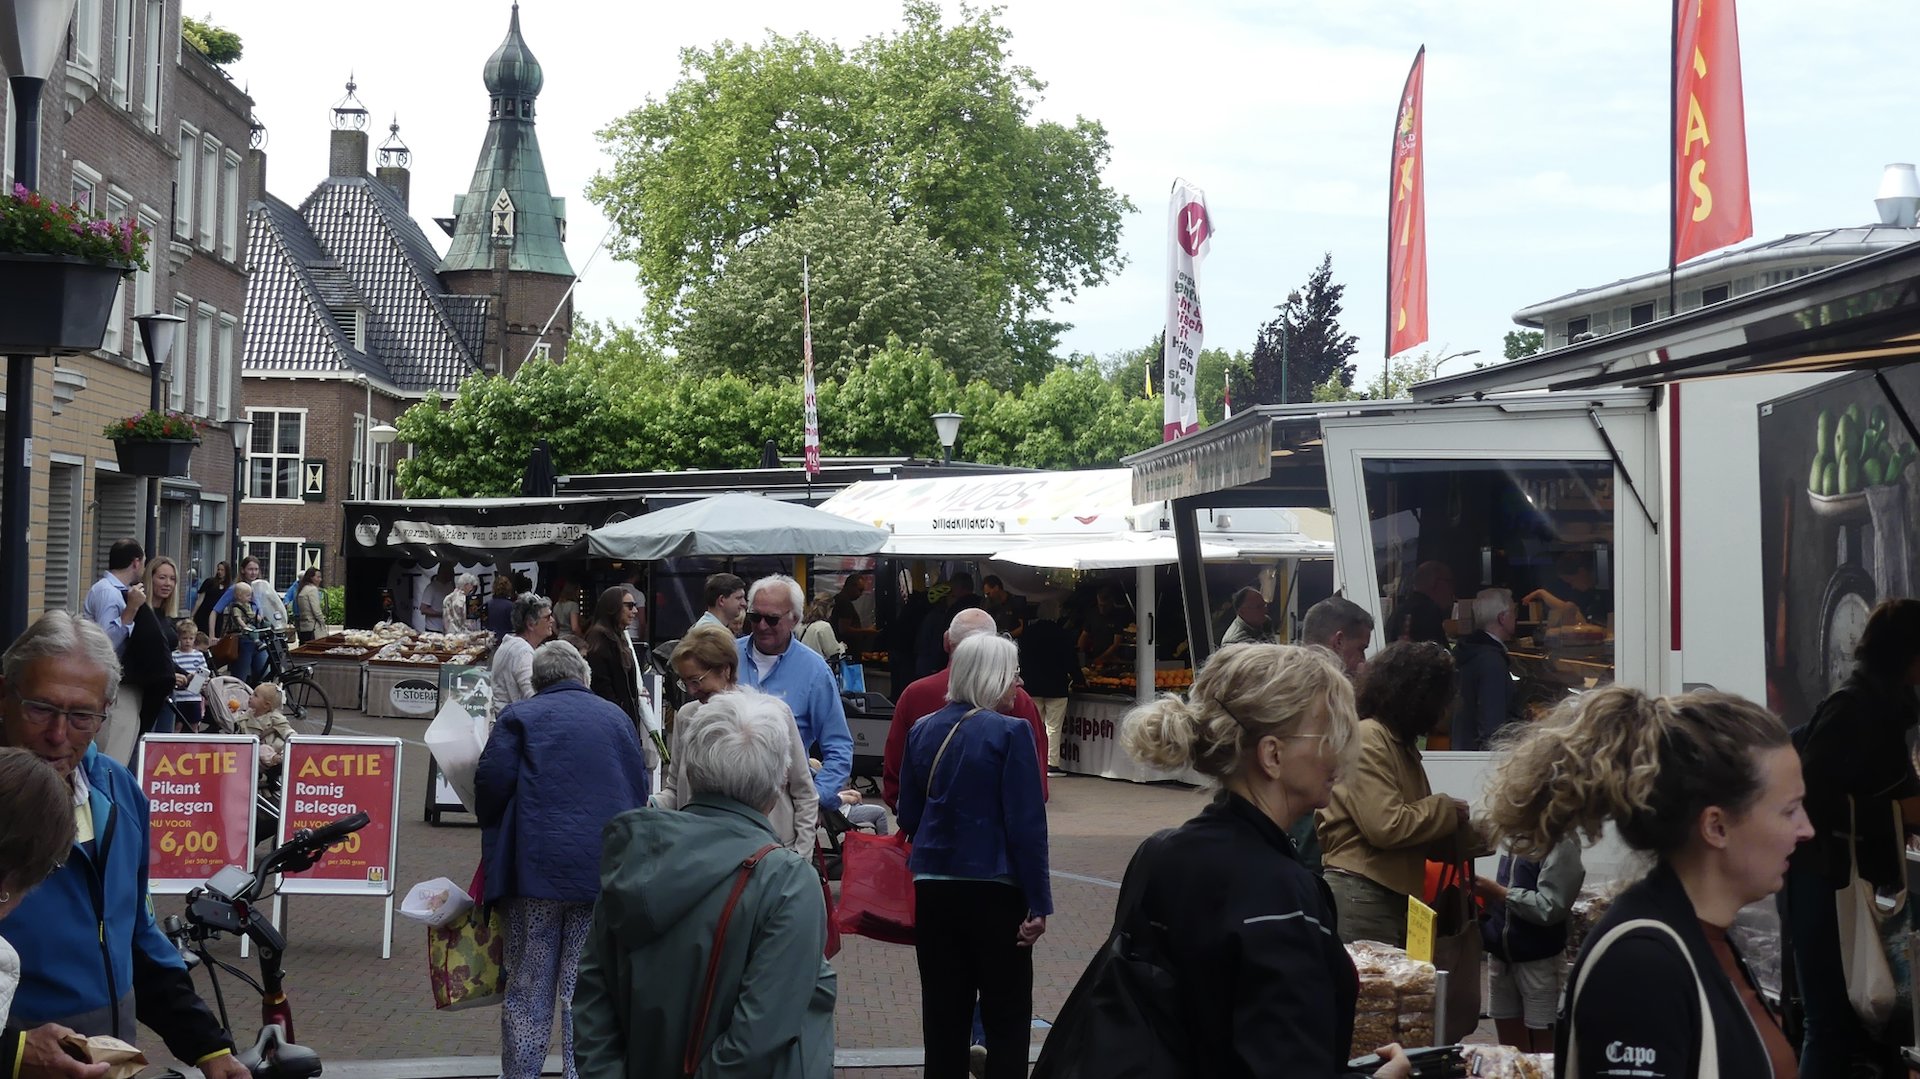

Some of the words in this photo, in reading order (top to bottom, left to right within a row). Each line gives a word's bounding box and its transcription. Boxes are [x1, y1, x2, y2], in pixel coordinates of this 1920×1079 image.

[472, 531, 486, 541] van
[488, 529, 498, 541] de
[403, 690, 439, 701] STOEPJE
[153, 752, 238, 777] ACTIE
[298, 753, 382, 778] ACTIE
[151, 781, 201, 795] Pikant
[295, 782, 344, 798] Romig
[149, 799, 213, 815] Belegen
[294, 800, 357, 816] Belegen
[165, 819, 192, 828] VOOR
[293, 820, 307, 828] NU
[309, 820, 333, 828] VOO
[160, 831, 218, 857] 6,00
[339, 858, 351, 866] 500
[1605, 1040, 1656, 1067] Capo
